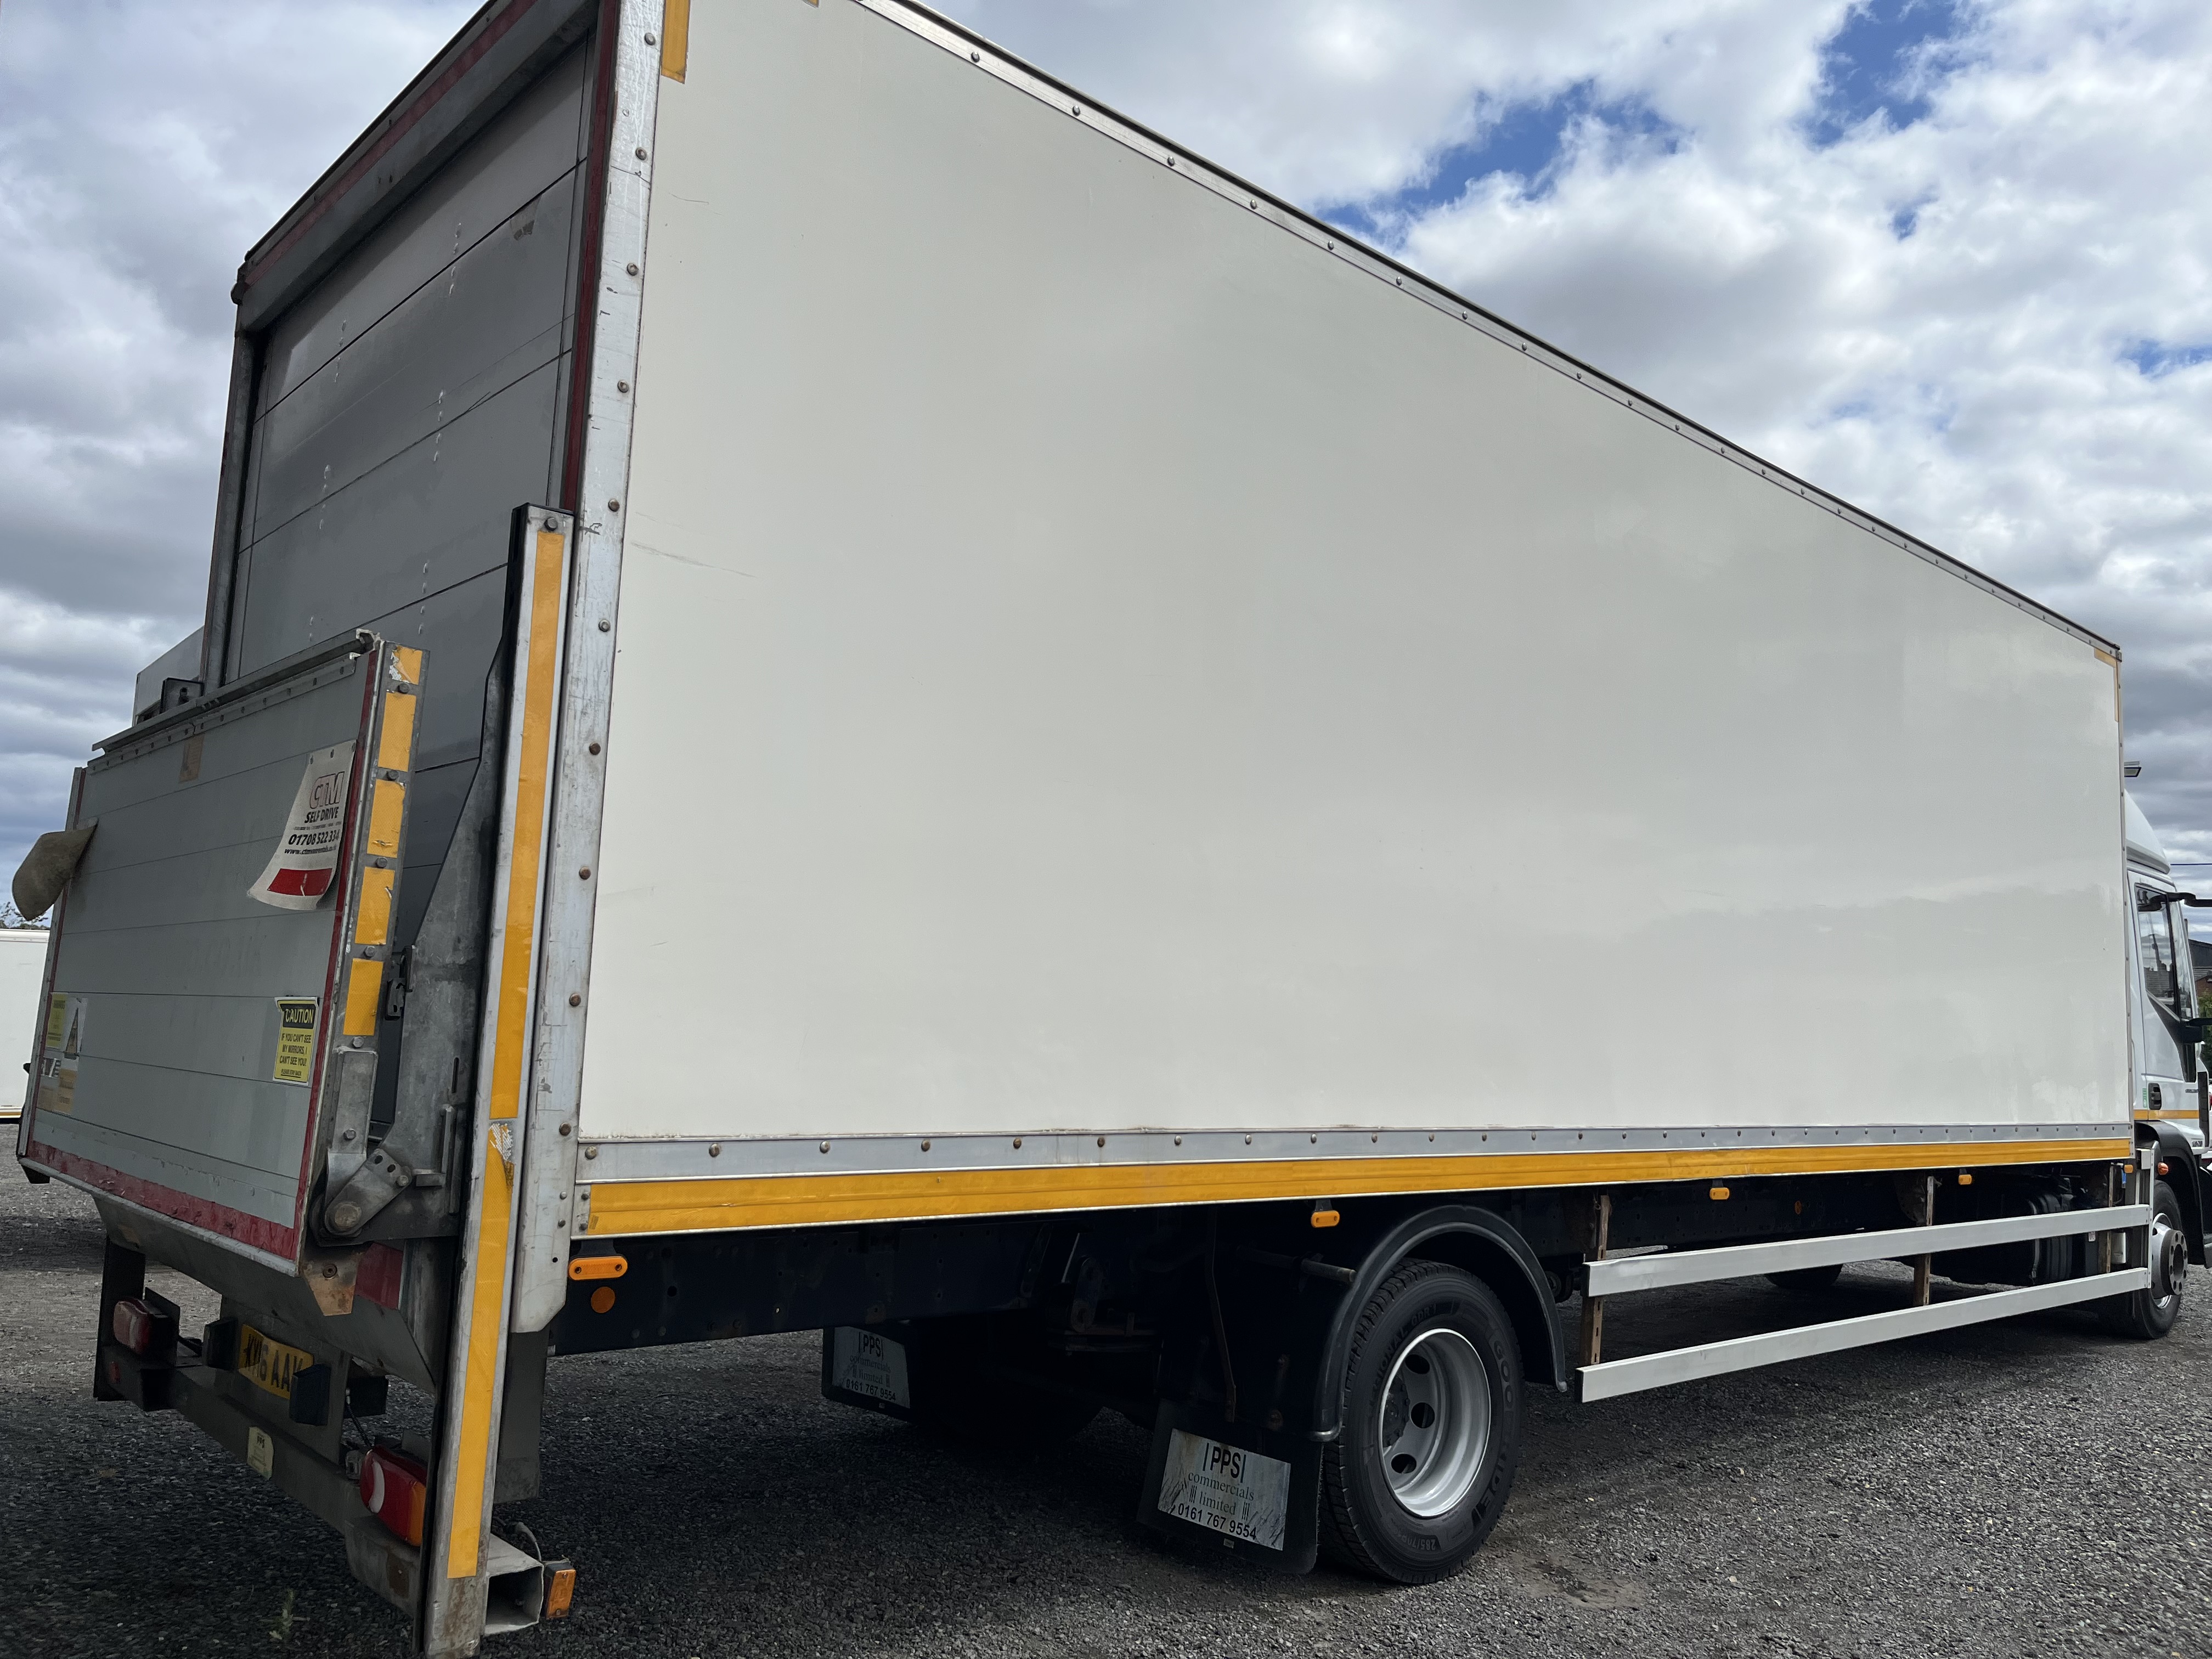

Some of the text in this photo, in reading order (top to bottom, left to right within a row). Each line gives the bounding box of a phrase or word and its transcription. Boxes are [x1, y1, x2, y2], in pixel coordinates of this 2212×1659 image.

[304, 806, 339, 823] SELF DRIVE
[288, 833, 317, 845] 01708
[317, 831, 329, 845] 522
[285, 1008, 314, 1024] CAUTION
[281, 1033, 285, 1041] IF
[293, 1034, 304, 1043] CAN'T
[303, 1035, 312, 1043] SEE
[279, 1055, 290, 1064] CAN'T
[849, 1353, 891, 1374] commercials
[859, 1368, 883, 1385] limited
[846, 1379, 896, 1402] 0161 767 9554
[1188, 1471, 1255, 1501] commercials
[1199, 1491, 1237, 1516] limited
[1178, 1502, 1257, 1541] 0161 767 9554
